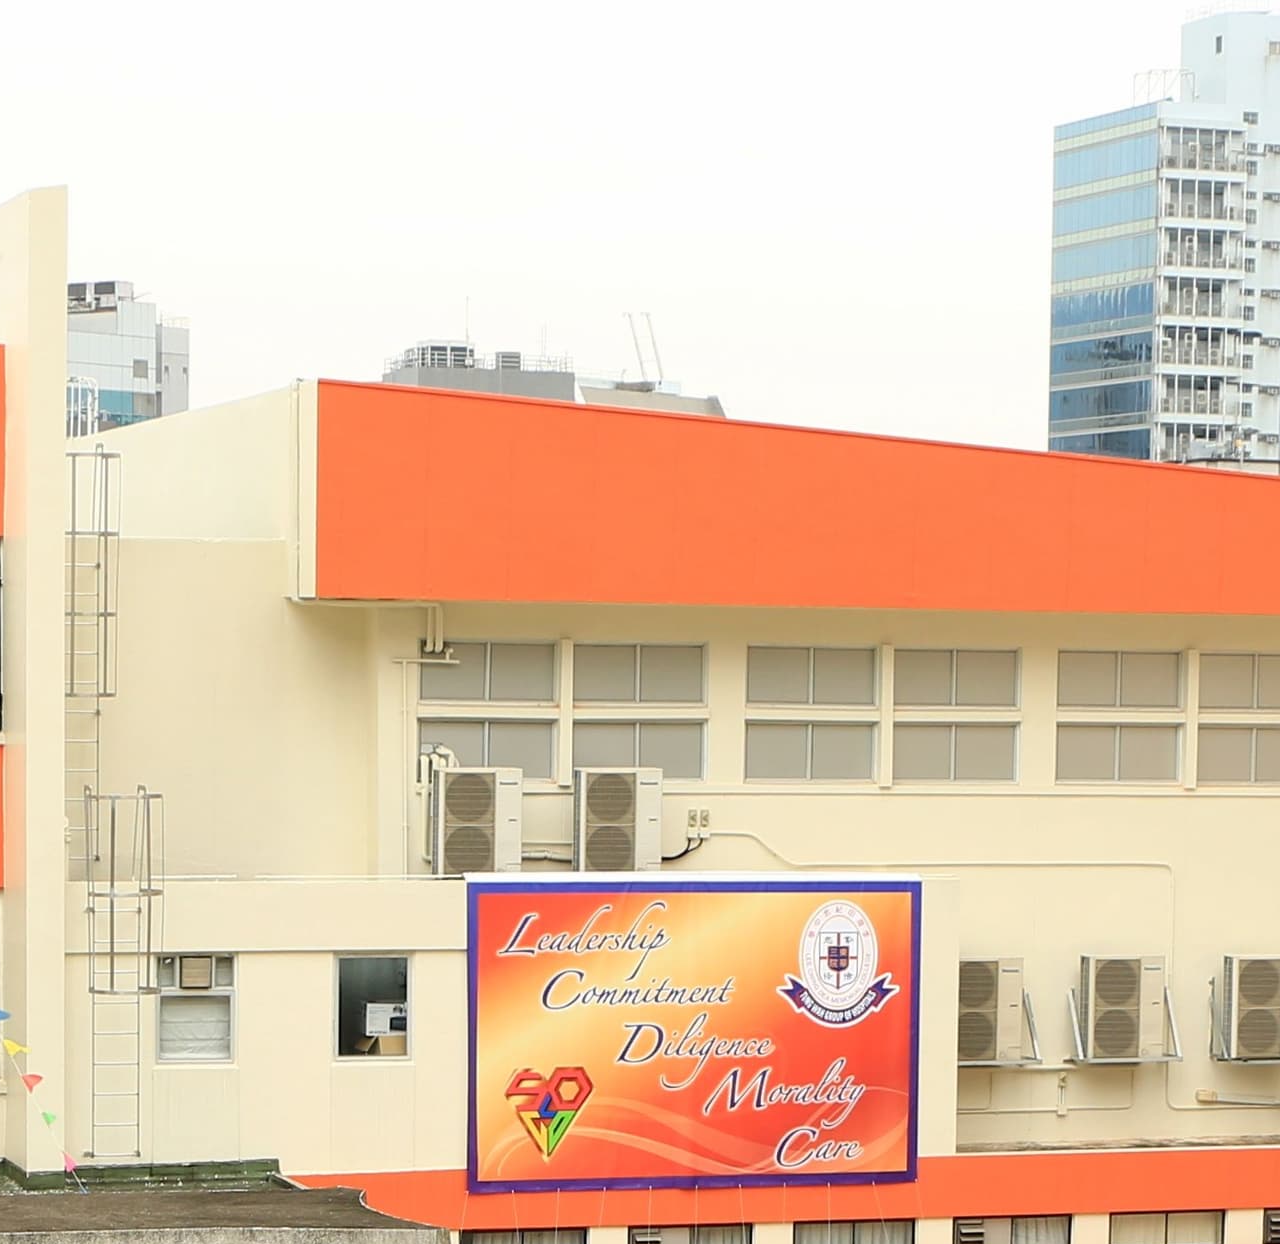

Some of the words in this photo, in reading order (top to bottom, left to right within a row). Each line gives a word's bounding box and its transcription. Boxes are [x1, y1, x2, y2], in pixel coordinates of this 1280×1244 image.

[499, 902, 671, 981] Leadership
[542, 969, 734, 1011] Commitment
[617, 1012, 772, 1089] Diligence
[704, 1058, 865, 1128] Morality
[775, 1127, 862, 1169] Care
